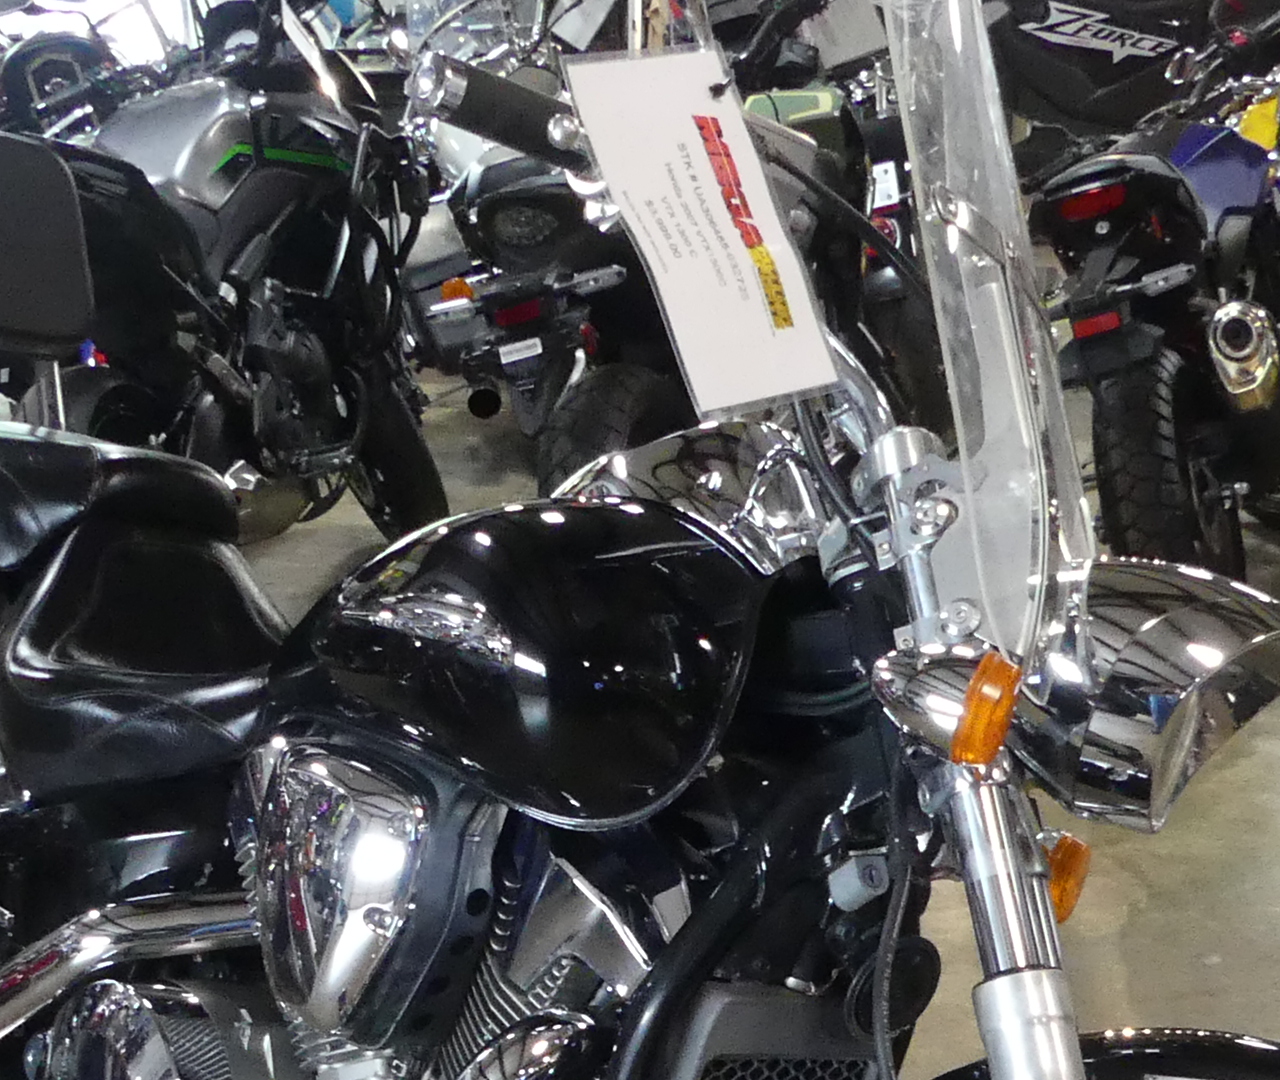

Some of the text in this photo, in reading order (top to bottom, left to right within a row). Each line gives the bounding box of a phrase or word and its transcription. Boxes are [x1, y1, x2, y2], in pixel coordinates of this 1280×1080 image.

[676, 142, 694, 172] STK
[688, 173, 699, 183] #
[660, 195, 676, 219] VTX
[664, 162, 682, 200] Honda
[680, 202, 699, 228] 2007
